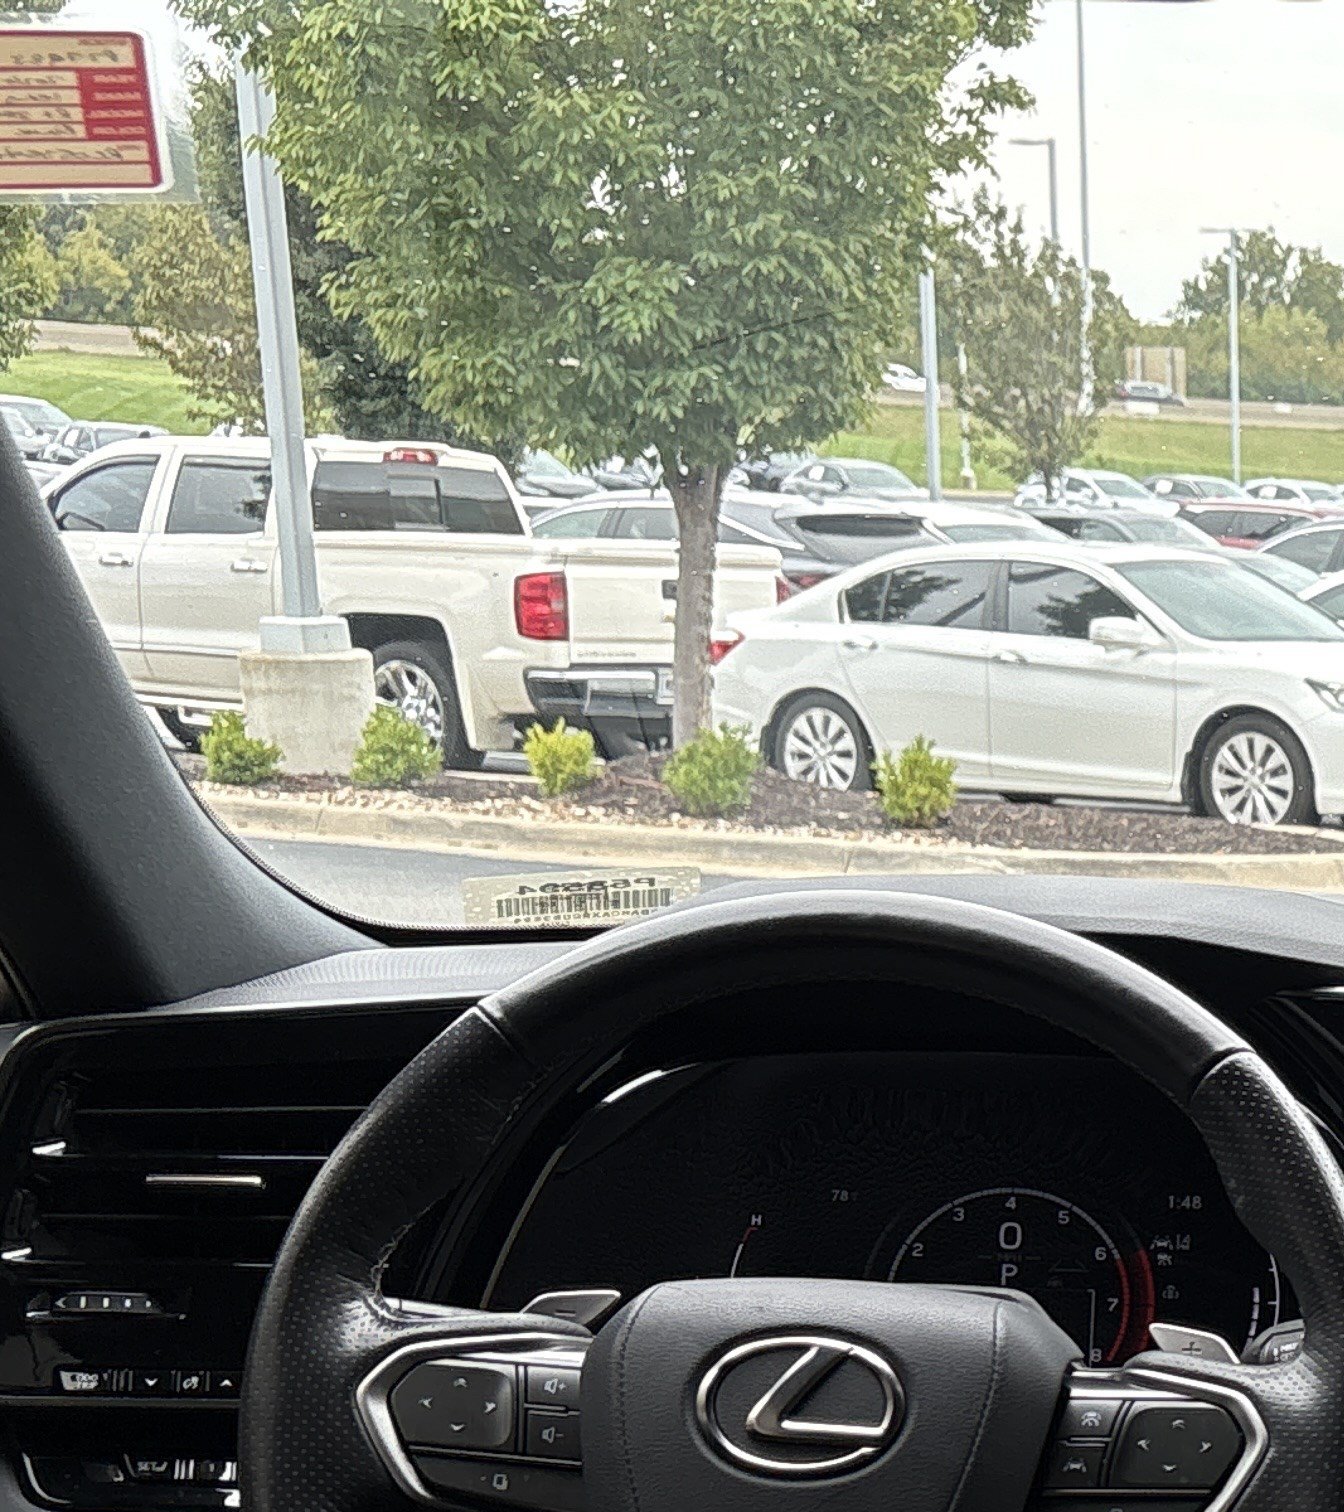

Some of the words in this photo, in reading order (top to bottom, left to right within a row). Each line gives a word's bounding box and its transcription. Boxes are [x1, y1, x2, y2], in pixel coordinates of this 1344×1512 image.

[1004, 1198, 1017, 1210] 4
[1168, 1195, 1202, 1210] 1:48
[751, 1214, 762, 1226] H
[952, 1208, 965, 1222] 3
[1058, 1210, 1070, 1225] 5
[999, 1222, 1022, 1250] 0
[912, 1243, 924, 1257] 2
[1094, 1247, 1107, 1261] 6
[1001, 1264, 1019, 1286] P
[1108, 1298, 1119, 1312] 7
